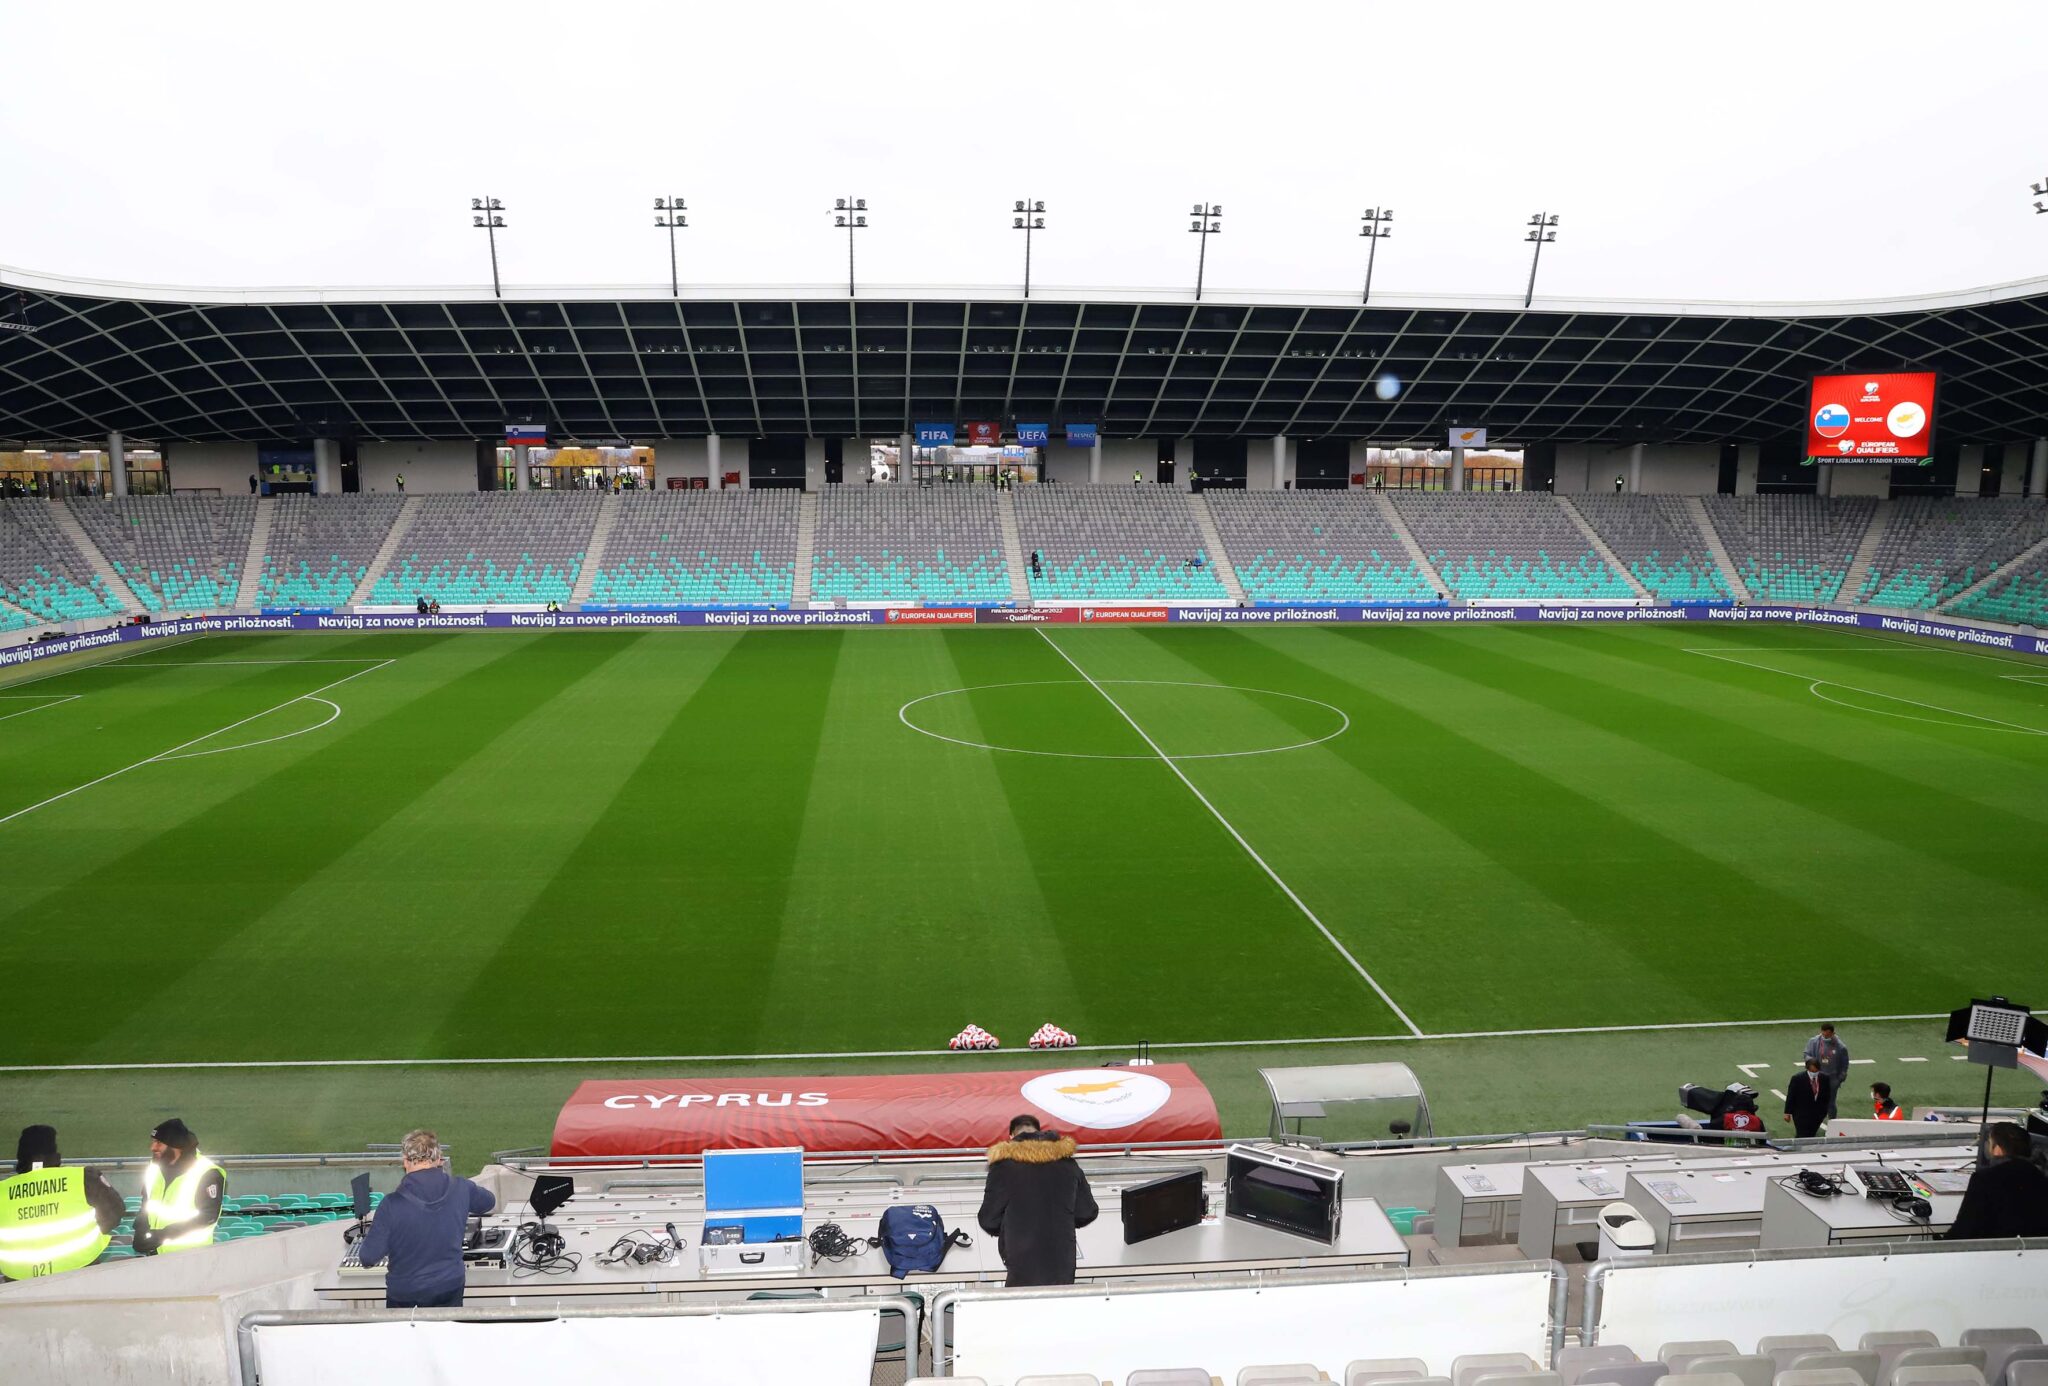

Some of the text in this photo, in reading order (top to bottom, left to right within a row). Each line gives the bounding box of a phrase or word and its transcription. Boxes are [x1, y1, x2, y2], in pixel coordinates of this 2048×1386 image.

[921, 431, 948, 440] FIFA
[1018, 431, 1047, 440] UEFA
[511, 614, 556, 627] Navijaj
[559, 616, 574, 625] za
[577, 615, 608, 625] nove
[705, 612, 750, 625] Navijaj
[752, 614, 767, 623] za
[771, 613, 801, 622] nove
[1009, 614, 1045, 622] Qualifiers
[1179, 609, 1222, 622] Navijaj
[1224, 611, 1239, 620] za
[1242, 611, 1271, 620] nove
[1362, 609, 1403, 621] Navijaj
[1406, 611, 1420, 619] za
[1423, 611, 1451, 619] nove
[1539, 608, 1579, 620] Navijaj
[1581, 610, 1594, 619] za
[1597, 610, 1624, 619] nove
[1709, 608, 1747, 620] Navijaj
[1750, 610, 1762, 618] za
[1765, 609, 1792, 619] nove
[141, 622, 178, 637] Navijaj
[180, 624, 192, 632] za
[195, 620, 221, 630] nove
[319, 615, 363, 629] Navijaj
[366, 618, 381, 627] za
[384, 617, 414, 626] nove
[1882, 618, 1918, 634] Navijaj
[1920, 625, 1931, 634] za
[1933, 627, 1956, 638] nove
[0, 646, 32, 665] Navijaj
[33, 647, 44, 657] za
[46, 642, 68, 654] nove
[604, 1092, 829, 1109] CYPRUS
[9, 1177, 68, 1200] VAROVANJE
[18, 1202, 60, 1220] SECURITY
[32, 1261, 53, 1278] 021
